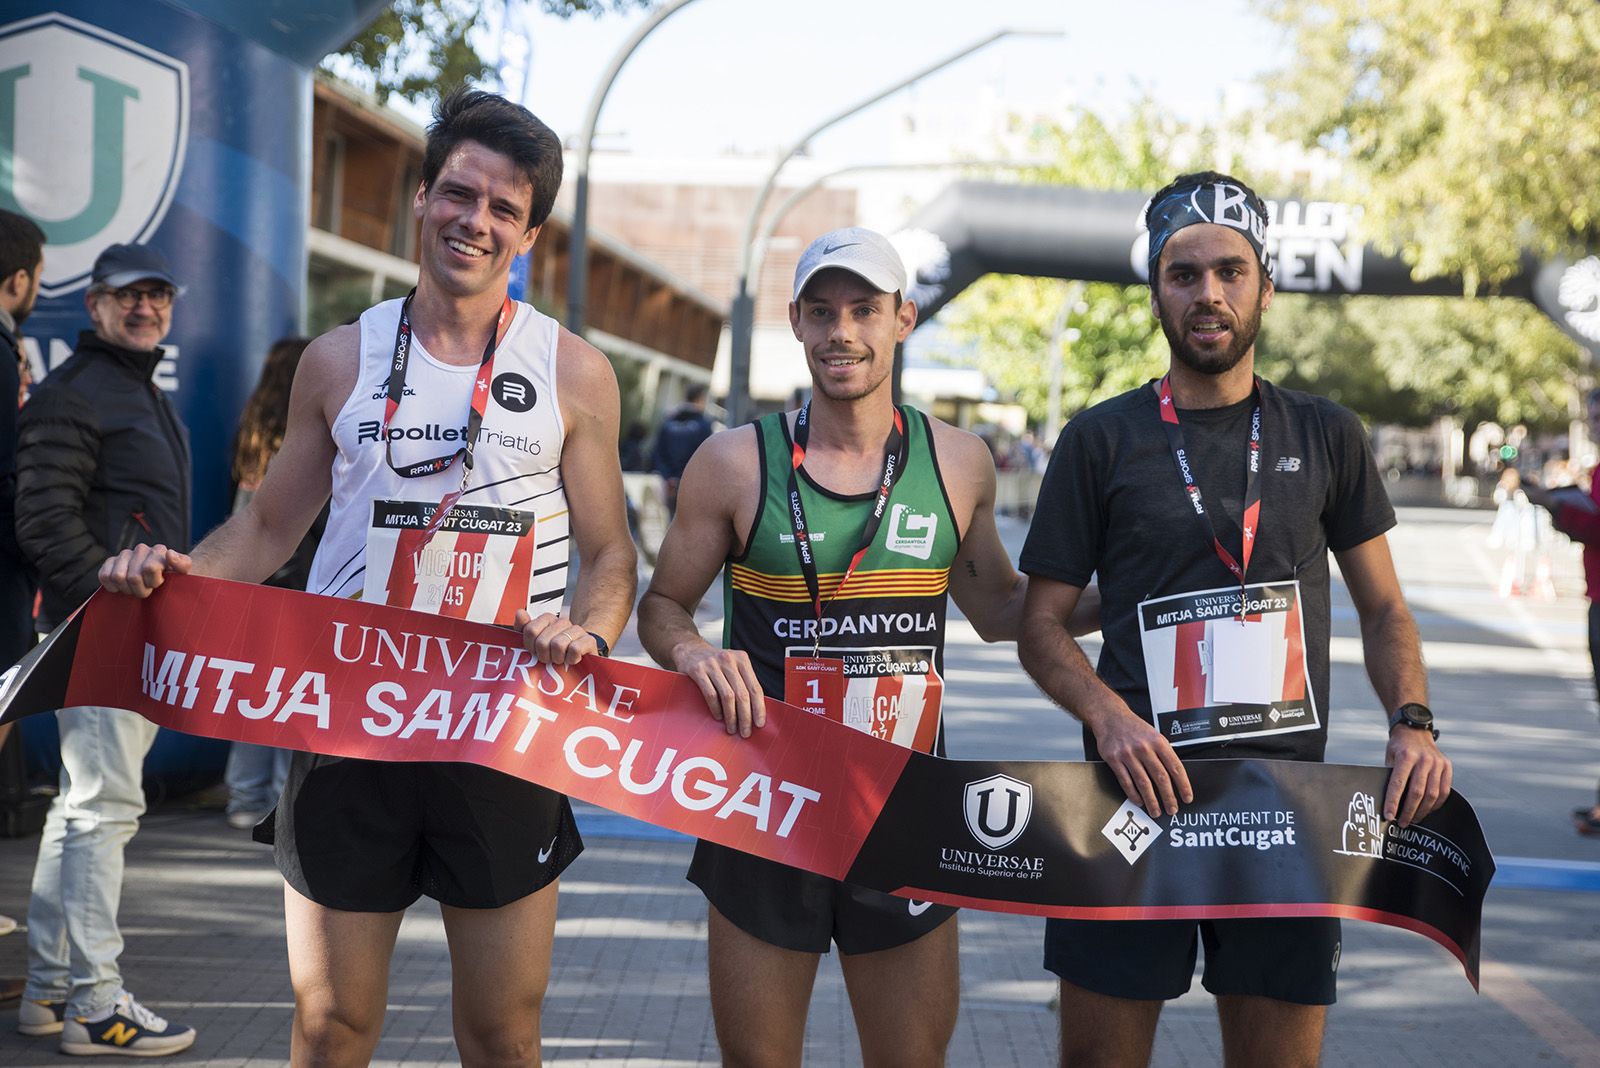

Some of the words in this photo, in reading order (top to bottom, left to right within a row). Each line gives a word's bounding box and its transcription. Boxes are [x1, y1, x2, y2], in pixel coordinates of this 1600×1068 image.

[395, 334, 407, 371] SPORTS
[358, 420, 468, 445] Ripollet
[478, 427, 542, 456] Triatló
[410, 464, 433, 475] RPM
[1176, 449, 1193, 484] SPORTS
[1251, 451, 1259, 473] RPM
[874, 495, 886, 518] RPM
[883, 454, 896, 487] SPORTS
[424, 507, 479, 518] UNERSAE
[791, 491, 804, 530] SPORTS
[1190, 492, 1204, 515] RPM
[385, 514, 418, 526] MITJA
[423, 516, 458, 528] SNT
[459, 519, 505, 532] CUGAT
[506, 522, 522, 532] 23
[412, 549, 485, 579] VICTOR
[801, 541, 812, 564] RPM
[427, 583, 464, 606] 2145
[1156, 610, 1193, 626] MITJA
[1196, 605, 1229, 619] SANT
[1274, 597, 1288, 609] 23
[773, 612, 937, 639] CERDANYOLA
[843, 654, 892, 664] UNIVERSAE
[843, 663, 875, 675] SANT
[876, 661, 911, 674] CUGAT
[332, 622, 641, 723] UNIVERSAE
[806, 679, 824, 704] 1
[843, 694, 908, 731] ARÇAL
[141, 642, 331, 729] MITJA
[362, 681, 559, 754] SANT
[563, 726, 822, 838] CUGAT
[1170, 811, 1271, 826] AJUNTAMENT
[1275, 811, 1295, 824] DE
[1169, 826, 1296, 850] SantCugat
[941, 847, 1045, 871] UNIVERSAE
[1397, 845, 1433, 865] CUGAT
[1400, 828, 1471, 877] MUNTANYENC
[940, 861, 976, 874] Instituto
[977, 867, 1015, 879] Superior
[1016, 870, 1029, 880] de
[1030, 871, 1043, 880] FP
